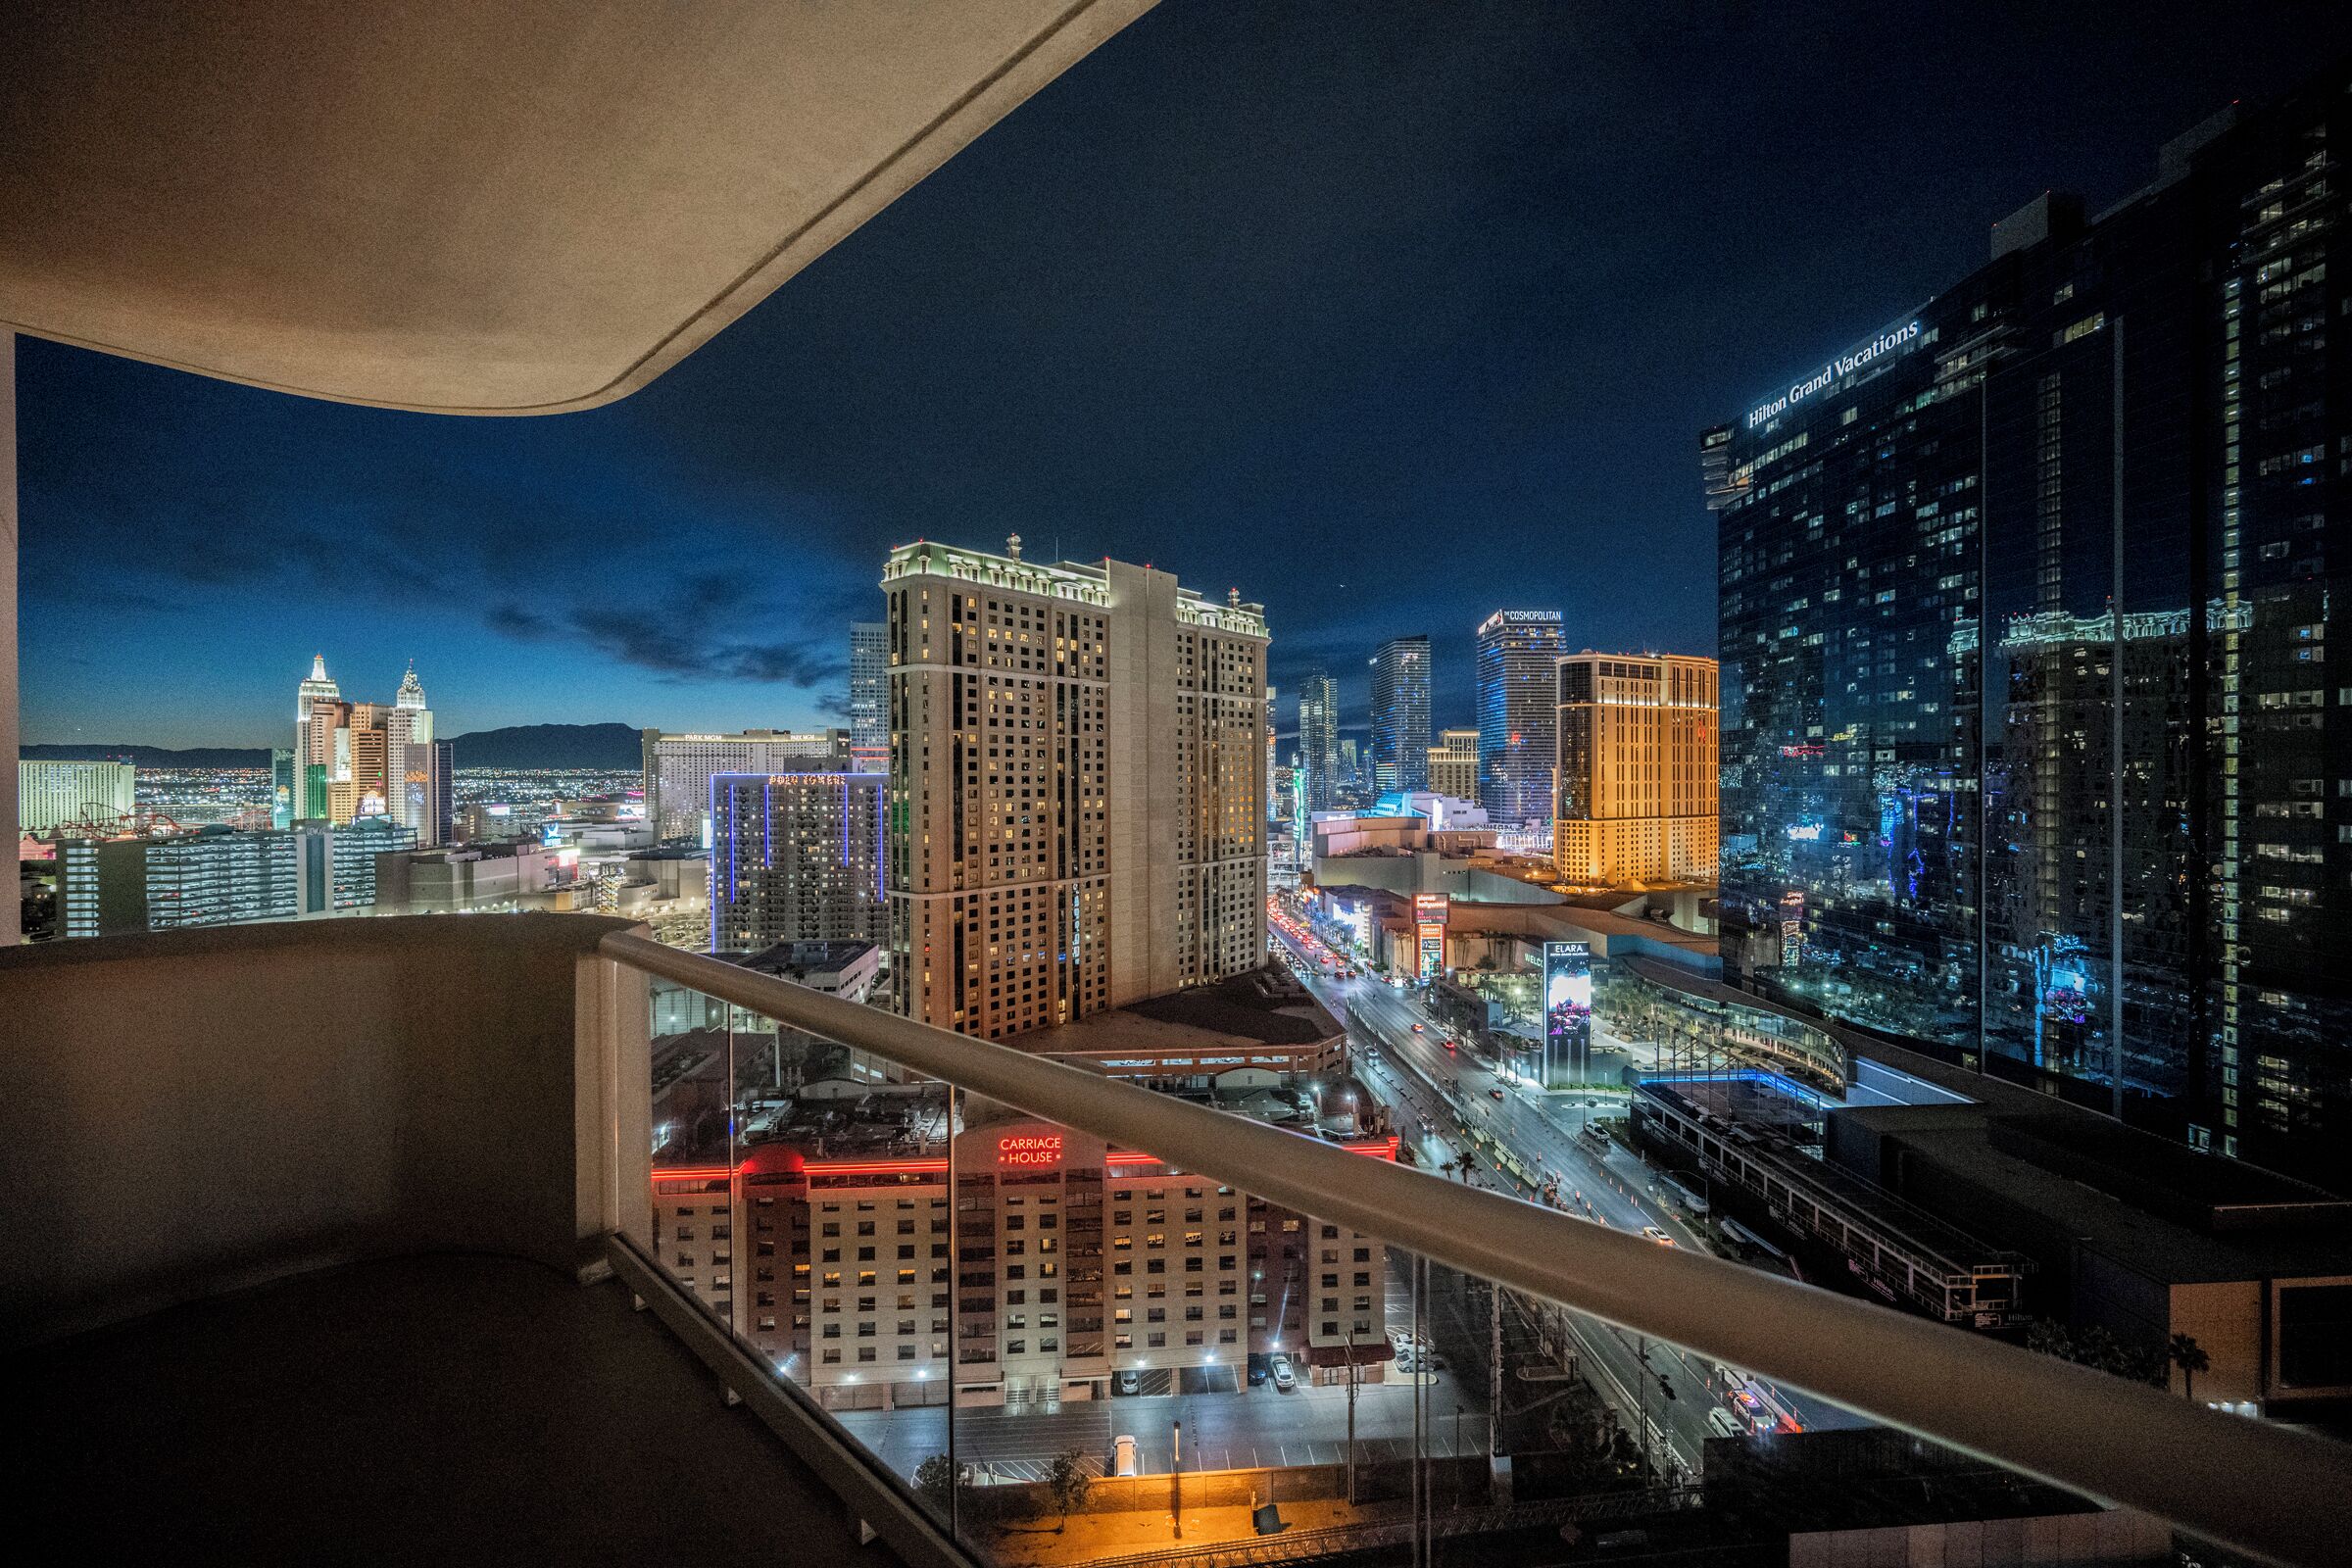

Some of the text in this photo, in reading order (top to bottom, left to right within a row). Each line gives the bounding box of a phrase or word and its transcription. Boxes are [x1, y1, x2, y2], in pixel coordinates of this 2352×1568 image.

[1749, 320, 1918, 429] Hilton Grand Vacations
[1510, 611, 1561, 620] COSMOPOLITAN
[1001, 1138, 1060, 1150] CARRIAGE
[1009, 1152, 1053, 1164] HOUSE
